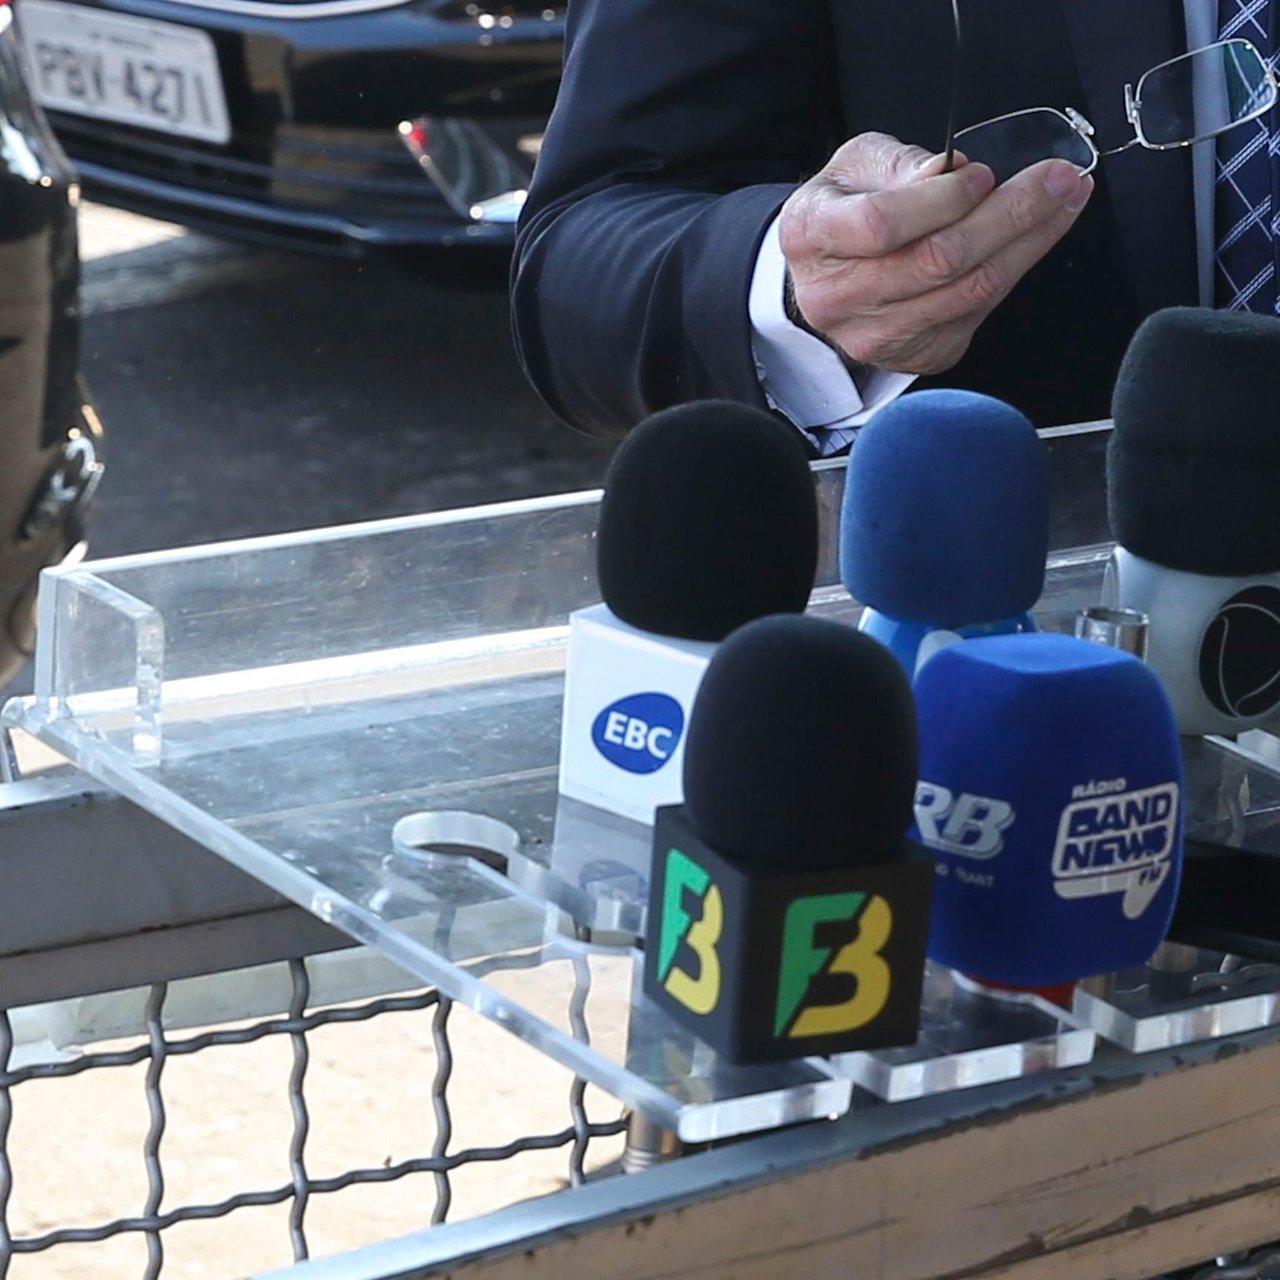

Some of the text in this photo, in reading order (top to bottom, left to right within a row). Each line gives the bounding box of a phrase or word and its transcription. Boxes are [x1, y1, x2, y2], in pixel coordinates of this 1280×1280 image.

[603, 709, 674, 760] EBC
[1071, 776, 1128, 800] RÁDIO
[1067, 791, 1173, 839] BAND
[1059, 823, 1170, 872] NEWS
